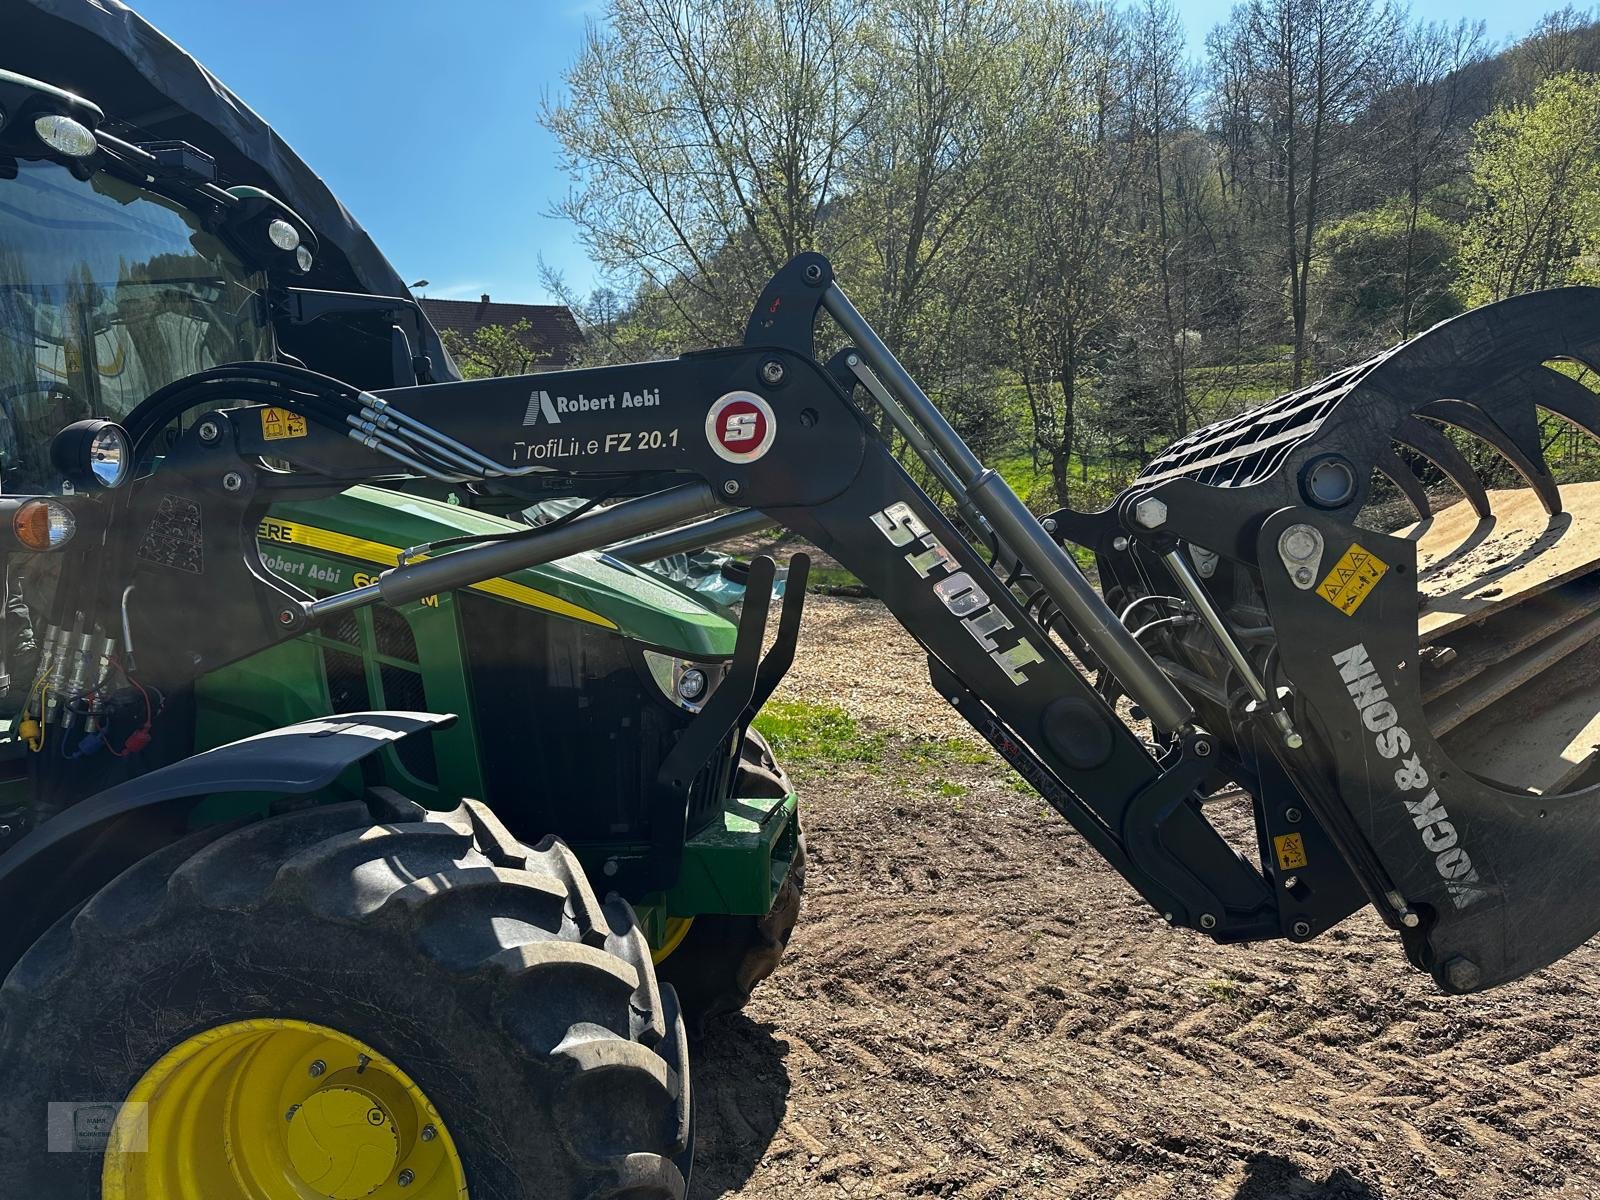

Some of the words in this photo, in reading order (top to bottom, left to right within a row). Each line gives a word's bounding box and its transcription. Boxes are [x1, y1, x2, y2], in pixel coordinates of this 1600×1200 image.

[557, 393, 616, 413] Robert
[621, 388, 661, 409] Aebi
[604, 432, 632, 453] FZ
[637, 428, 680, 451] 20.1
[723, 412, 758, 442] S
[307, 563, 342, 584] Aebi
[868, 500, 1046, 686] STOLL
[1331, 642, 1412, 760] SOHN
[1394, 751, 1429, 791] &
[1403, 786, 1488, 910] KOCK
